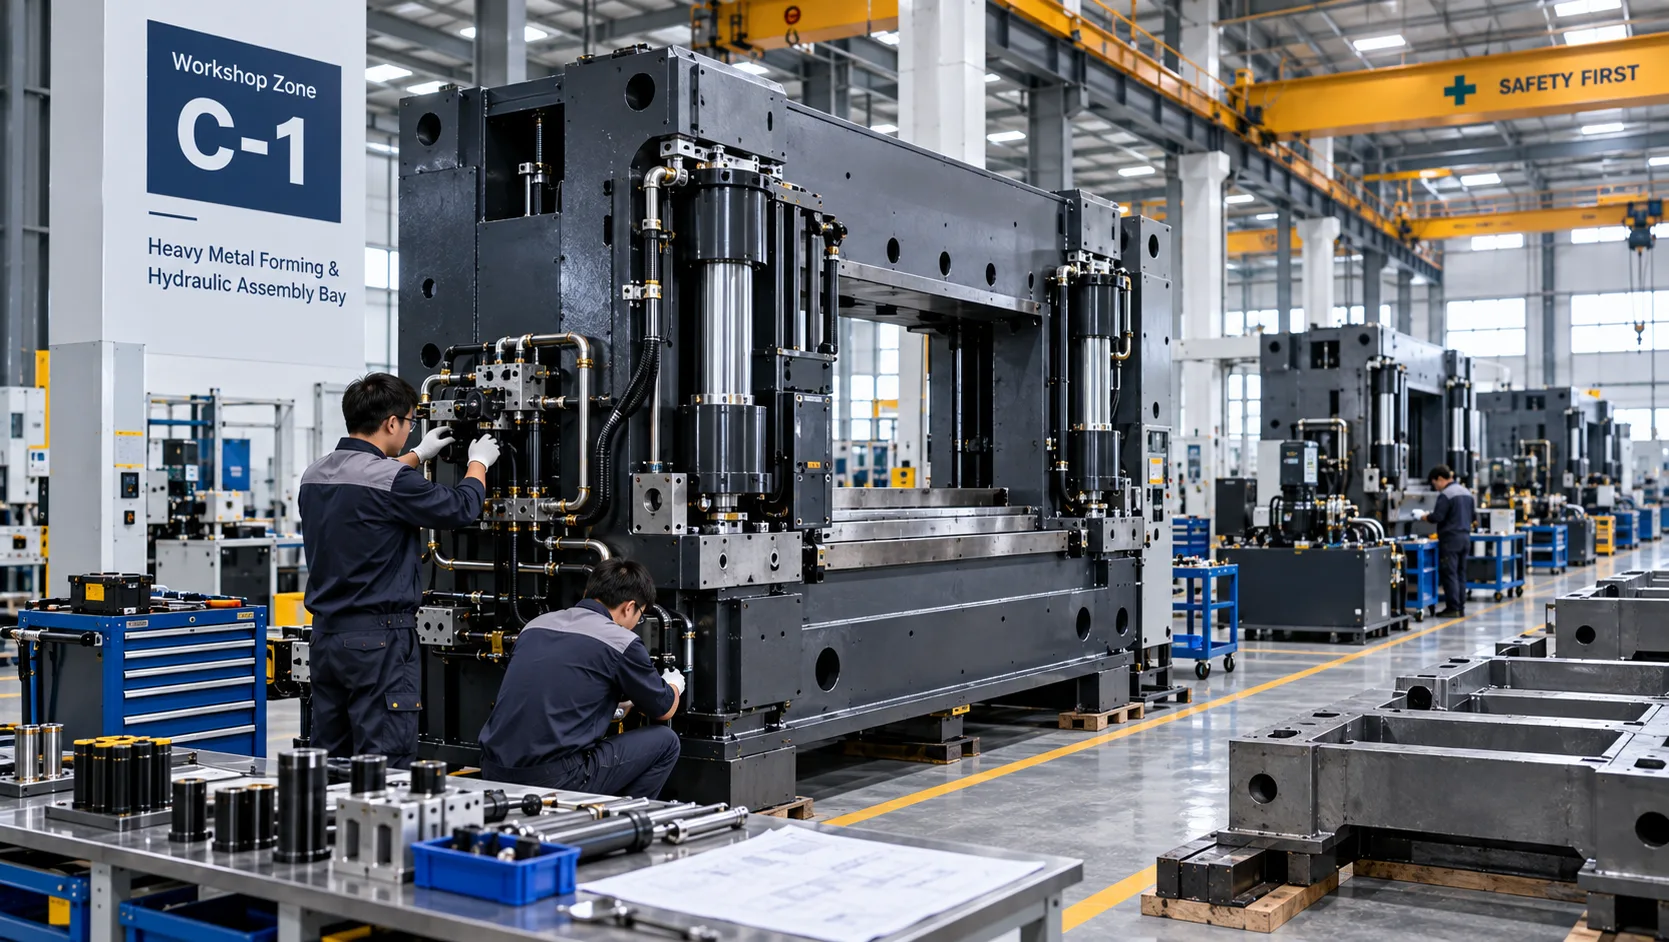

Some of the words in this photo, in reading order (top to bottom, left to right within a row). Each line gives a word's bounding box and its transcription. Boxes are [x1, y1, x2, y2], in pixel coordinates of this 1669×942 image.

[172, 51, 268, 92] Workshop
[273, 73, 317, 99] Zone
[1499, 72, 1573, 95] SAFETY
[1581, 64, 1640, 87] FIRST
[177, 97, 305, 186] C-1
[148, 237, 204, 265] Heavy
[208, 246, 255, 267] Metal
[260, 252, 324, 280] Forming
[328, 261, 340, 278] &
[148, 267, 232, 293] Hydraulic
[237, 276, 315, 305] Assembly
[319, 286, 347, 308] Bay
